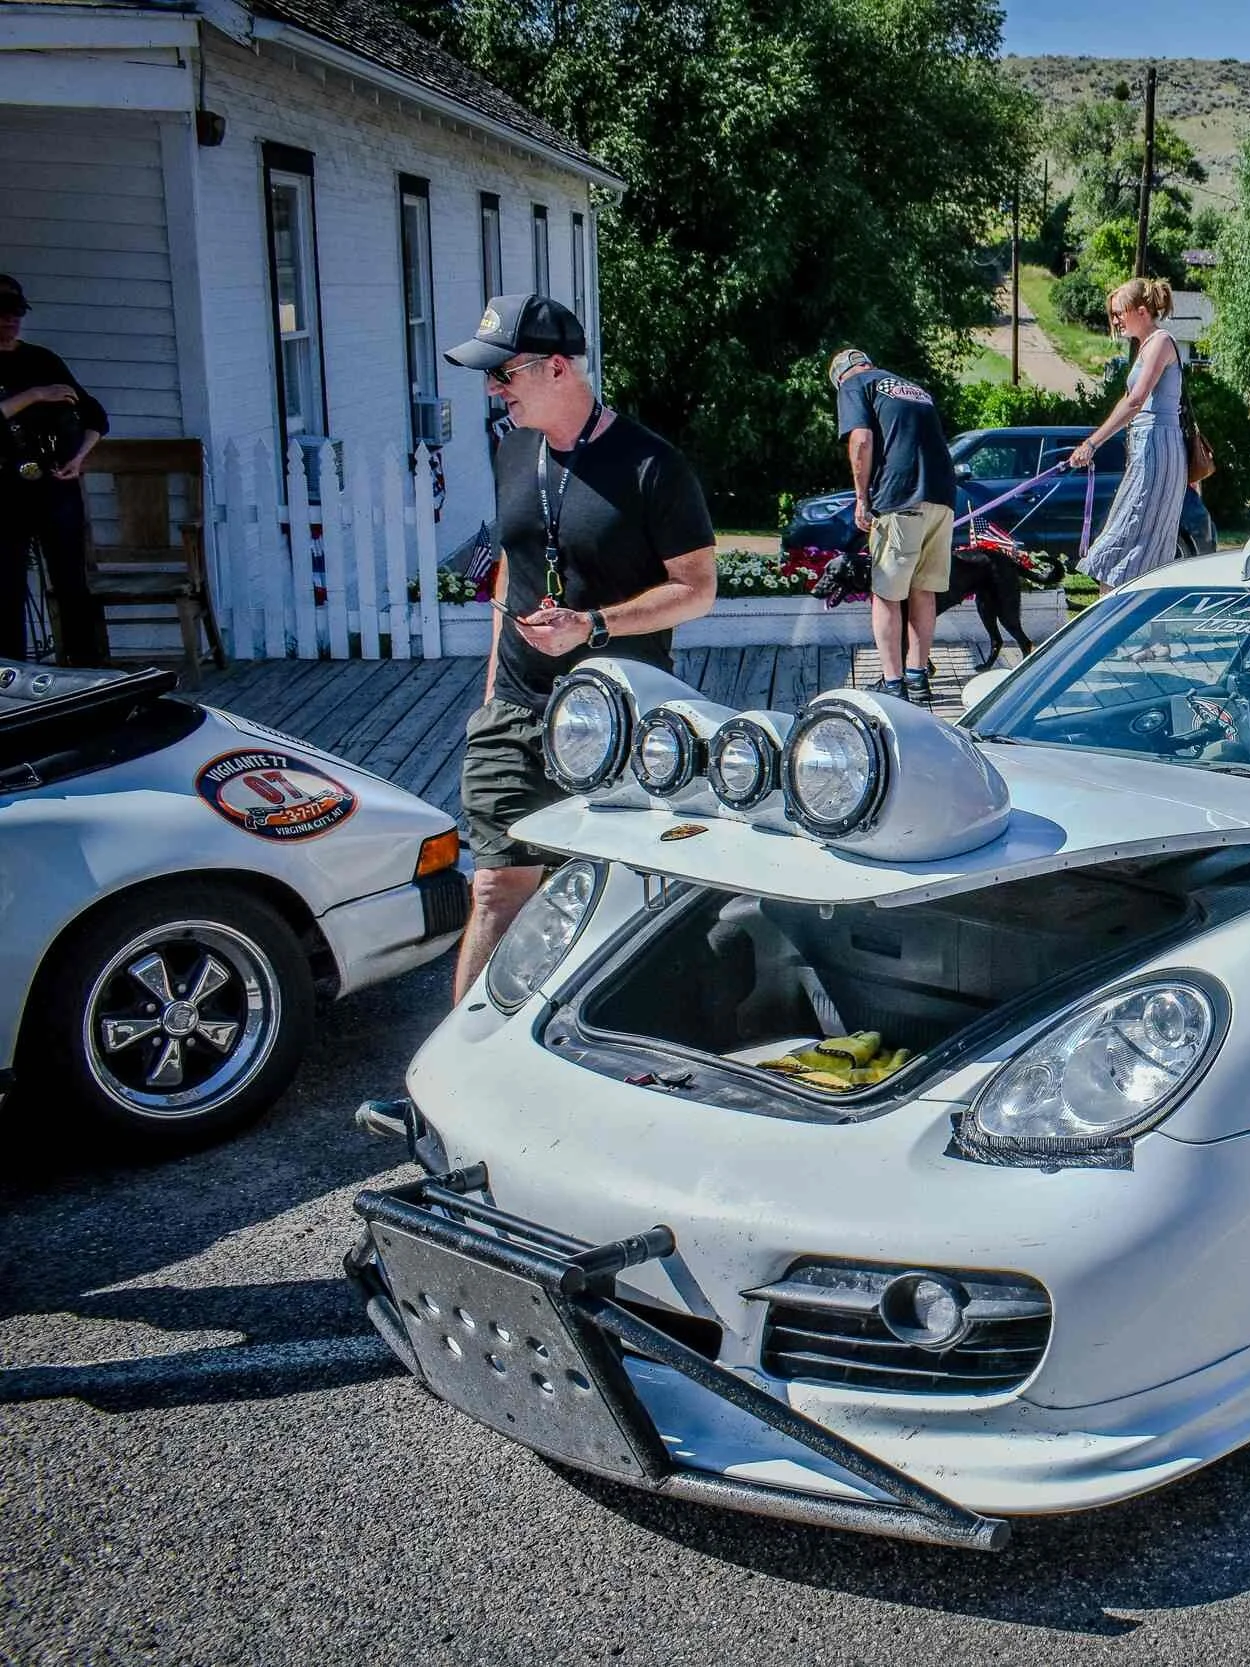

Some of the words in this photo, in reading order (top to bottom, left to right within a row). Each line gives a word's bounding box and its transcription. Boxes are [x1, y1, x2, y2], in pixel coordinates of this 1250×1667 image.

[204, 755, 270, 782] VIGILANTE
[267, 755, 287, 769] 77
[242, 771, 303, 805] 07
[275, 821, 314, 836] VIRGINIA
[312, 814, 335, 829] CITY,
[331, 806, 344, 821] MT
